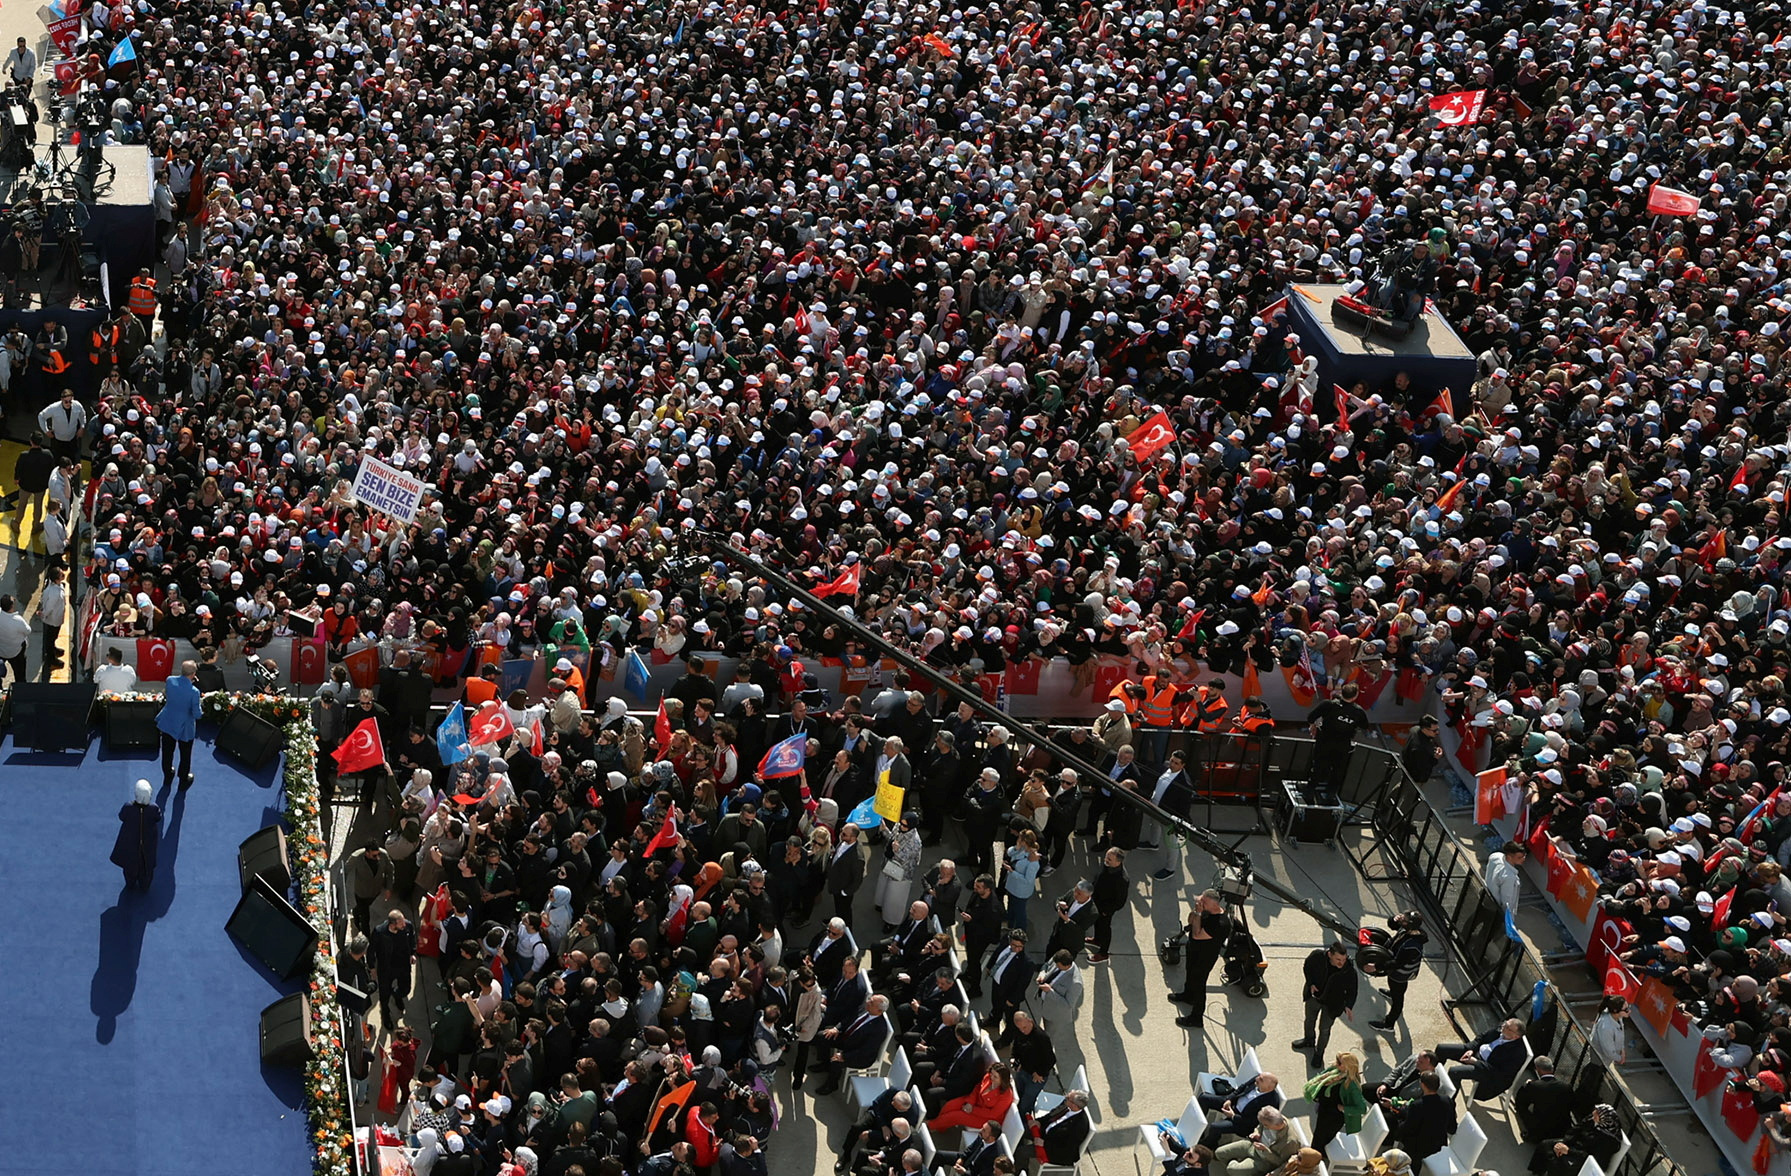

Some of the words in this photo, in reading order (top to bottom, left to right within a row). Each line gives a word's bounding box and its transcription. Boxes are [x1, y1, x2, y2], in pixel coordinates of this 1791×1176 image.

[361, 471, 386, 494] SEN
[386, 484, 416, 508] BİZE
[365, 461, 398, 484] TÜRKİYE
[397, 477, 420, 494] SANA
[355, 485, 411, 520] EMANETSİN
